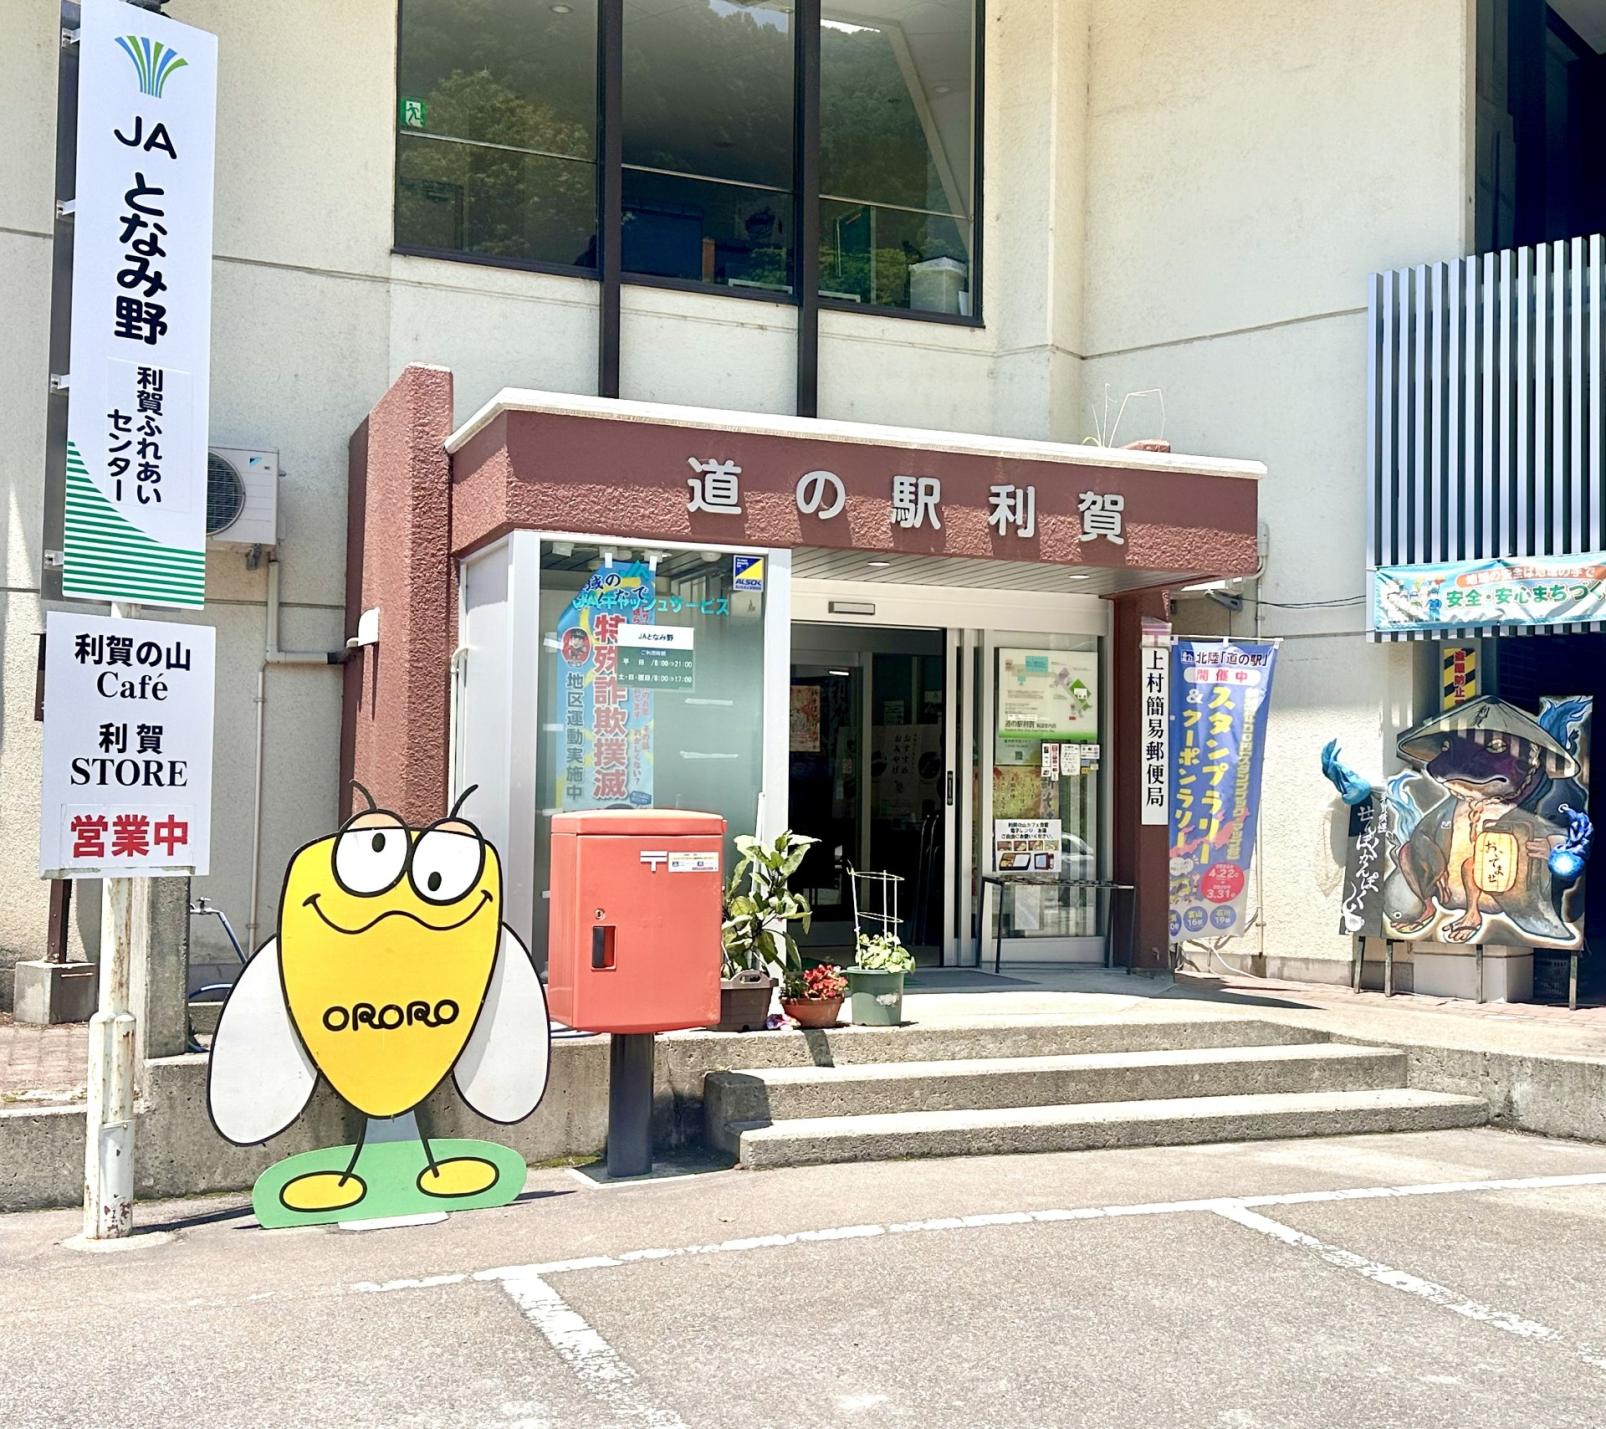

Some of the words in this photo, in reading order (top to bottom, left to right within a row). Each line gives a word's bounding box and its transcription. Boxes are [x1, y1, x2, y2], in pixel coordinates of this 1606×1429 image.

[114, 116, 177, 159] JA
[114, 172, 167, 345] となみ野
[136, 366, 163, 504] 利賀ふれあい
[106, 409, 132, 502] センター
[75, 633, 191, 671] 利賀の山
[638, 633, 674, 641] JAとなみ野
[1196, 651, 1268, 666] 北陸「道の駅」
[1196, 669, 1248, 682] 開催中
[96, 671, 169, 701] Café
[98, 722, 163, 755] 利賀
[566, 673, 584, 801] 地区運動実施中
[1146, 650, 1165, 807] 上村簡易郵便局
[70, 757, 188, 787] STORE
[1199, 686, 1236, 864] スタンプラリー
[70, 814, 189, 858] 営業中
[323, 999, 459, 1032] ORORO
